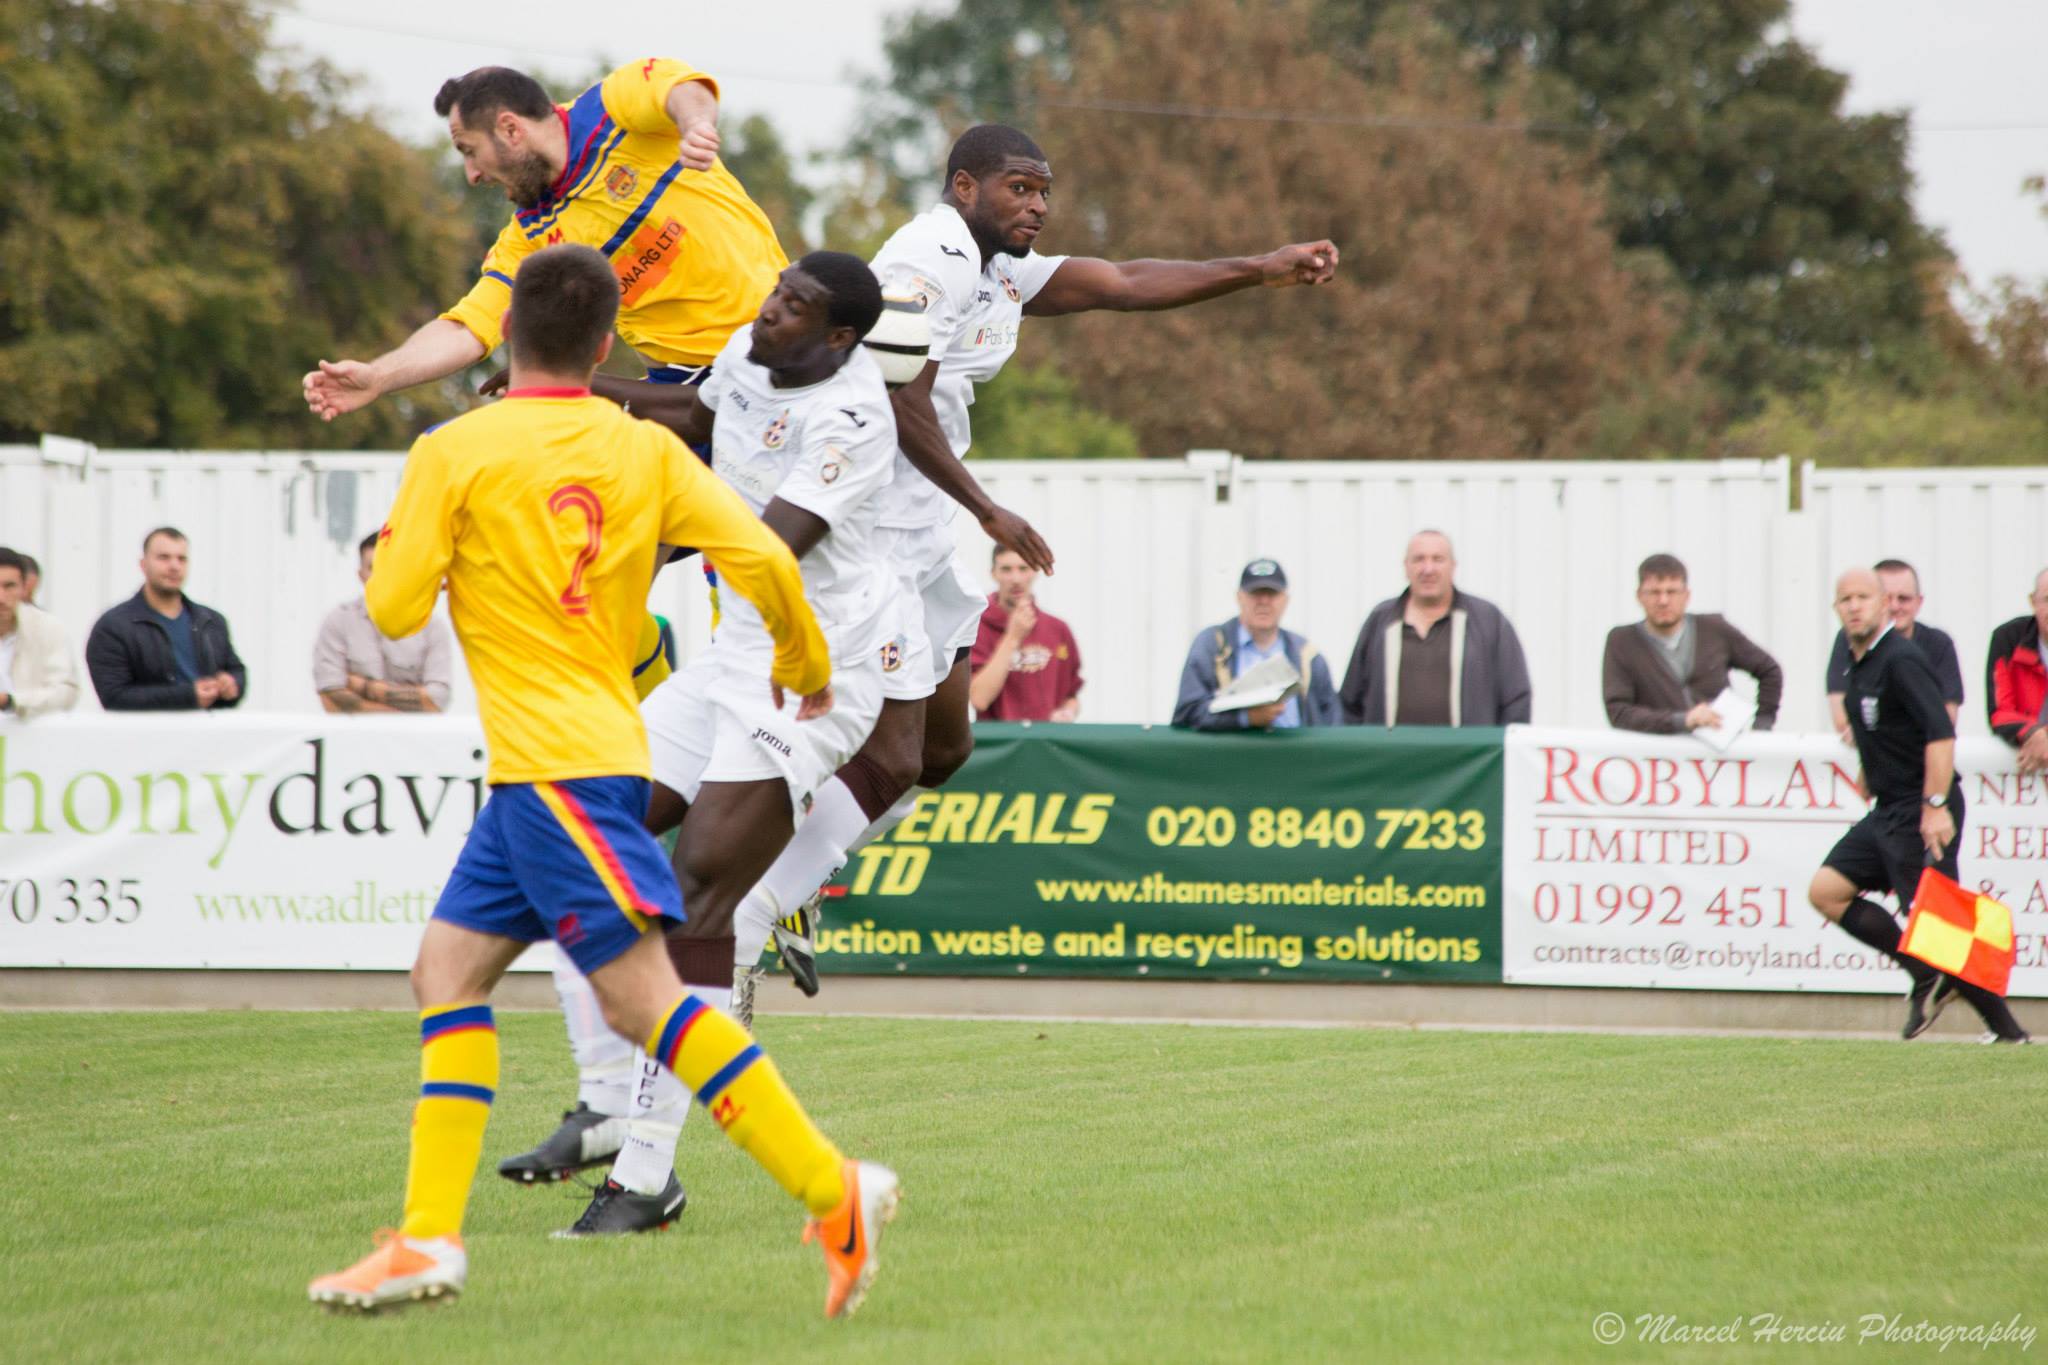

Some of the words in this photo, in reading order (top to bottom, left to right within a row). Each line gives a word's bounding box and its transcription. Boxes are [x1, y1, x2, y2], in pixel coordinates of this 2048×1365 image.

[656, 222, 681, 251] LTD
[548, 484, 604, 617] 2
[751, 727, 792, 757] joma
[869, 793, 1114, 843] ERIALS
[1147, 807, 1235, 847] 020
[1248, 808, 1364, 848] 8840
[1375, 810, 1485, 851] 7233
[1535, 827, 1750, 865] LIMITED
[55, 878, 142, 924] 335
[1036, 873, 1485, 907] www.thamesmaterials.com
[1534, 882, 1684, 926] 01992
[1706, 886, 1793, 928] 451
[932, 925, 1045, 956] waste
[1053, 922, 1124, 957] and
[1137, 923, 1301, 967] recycling
[1316, 925, 1481, 963] solutions
